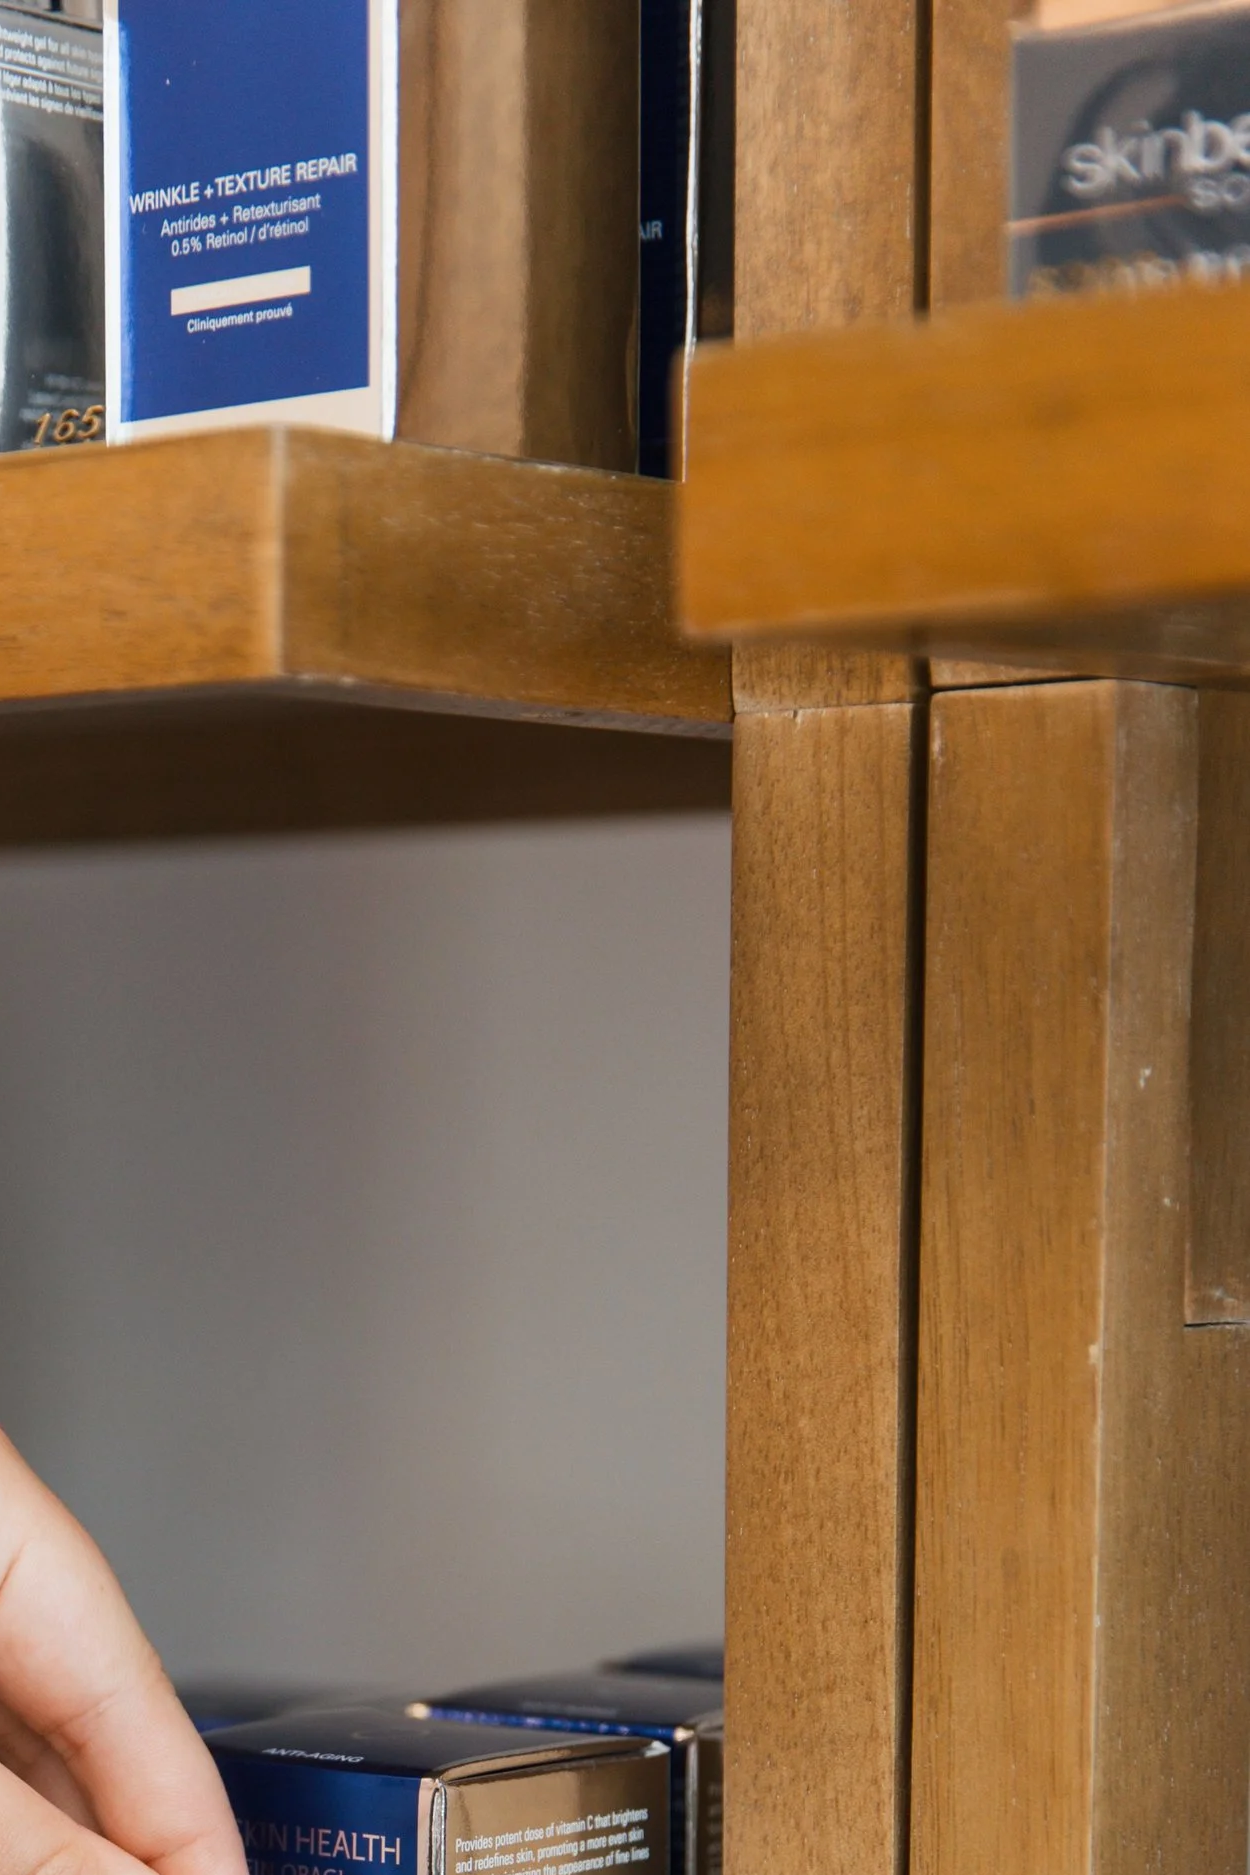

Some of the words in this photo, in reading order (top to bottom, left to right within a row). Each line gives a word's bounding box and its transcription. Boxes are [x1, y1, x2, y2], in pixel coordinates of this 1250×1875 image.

[129, 182, 200, 214] WRINKLE
[204, 183, 214, 200] +
[214, 163, 291, 198] TEXTURE
[295, 152, 358, 182] REPAIR
[161, 210, 216, 237] Antirides
[220, 212, 229, 226] +
[232, 192, 321, 224] Retexturisant
[170, 236, 202, 257] 0.5%
[206, 225, 248, 250] Retinol
[250, 225, 257, 244] /
[258, 216, 310, 242] d'rétinol
[186, 310, 254, 334] Cliniquement
[255, 302, 293, 325] prouvé
[34, 404, 106, 445] 165
[261, 1747, 364, 1764] ANTI-AGING
[295, 1825, 400, 1866] HEALTH
[455, 1835, 493, 1853] Provides
[495, 1830, 523, 1850] potent
[524, 1826, 544, 1842] dose
[545, 1822, 555, 1838] of
[556, 1817, 586, 1836] vitamin
[587, 1815, 594, 1831] C
[594, 1813, 611, 1829] that
[612, 1808, 648, 1828] brightens
[455, 1857, 473, 1874] and
[474, 1851, 514, 1871] redefines
[516, 1847, 536, 1863] skin,
[537, 1840, 578, 1863] promoting
[579, 1840, 586, 1852] a
[586, 1835, 607, 1850] more
[608, 1832, 628, 1846] even
[628, 1825, 645, 1842] skin
[605, 1850, 615, 1867] of
